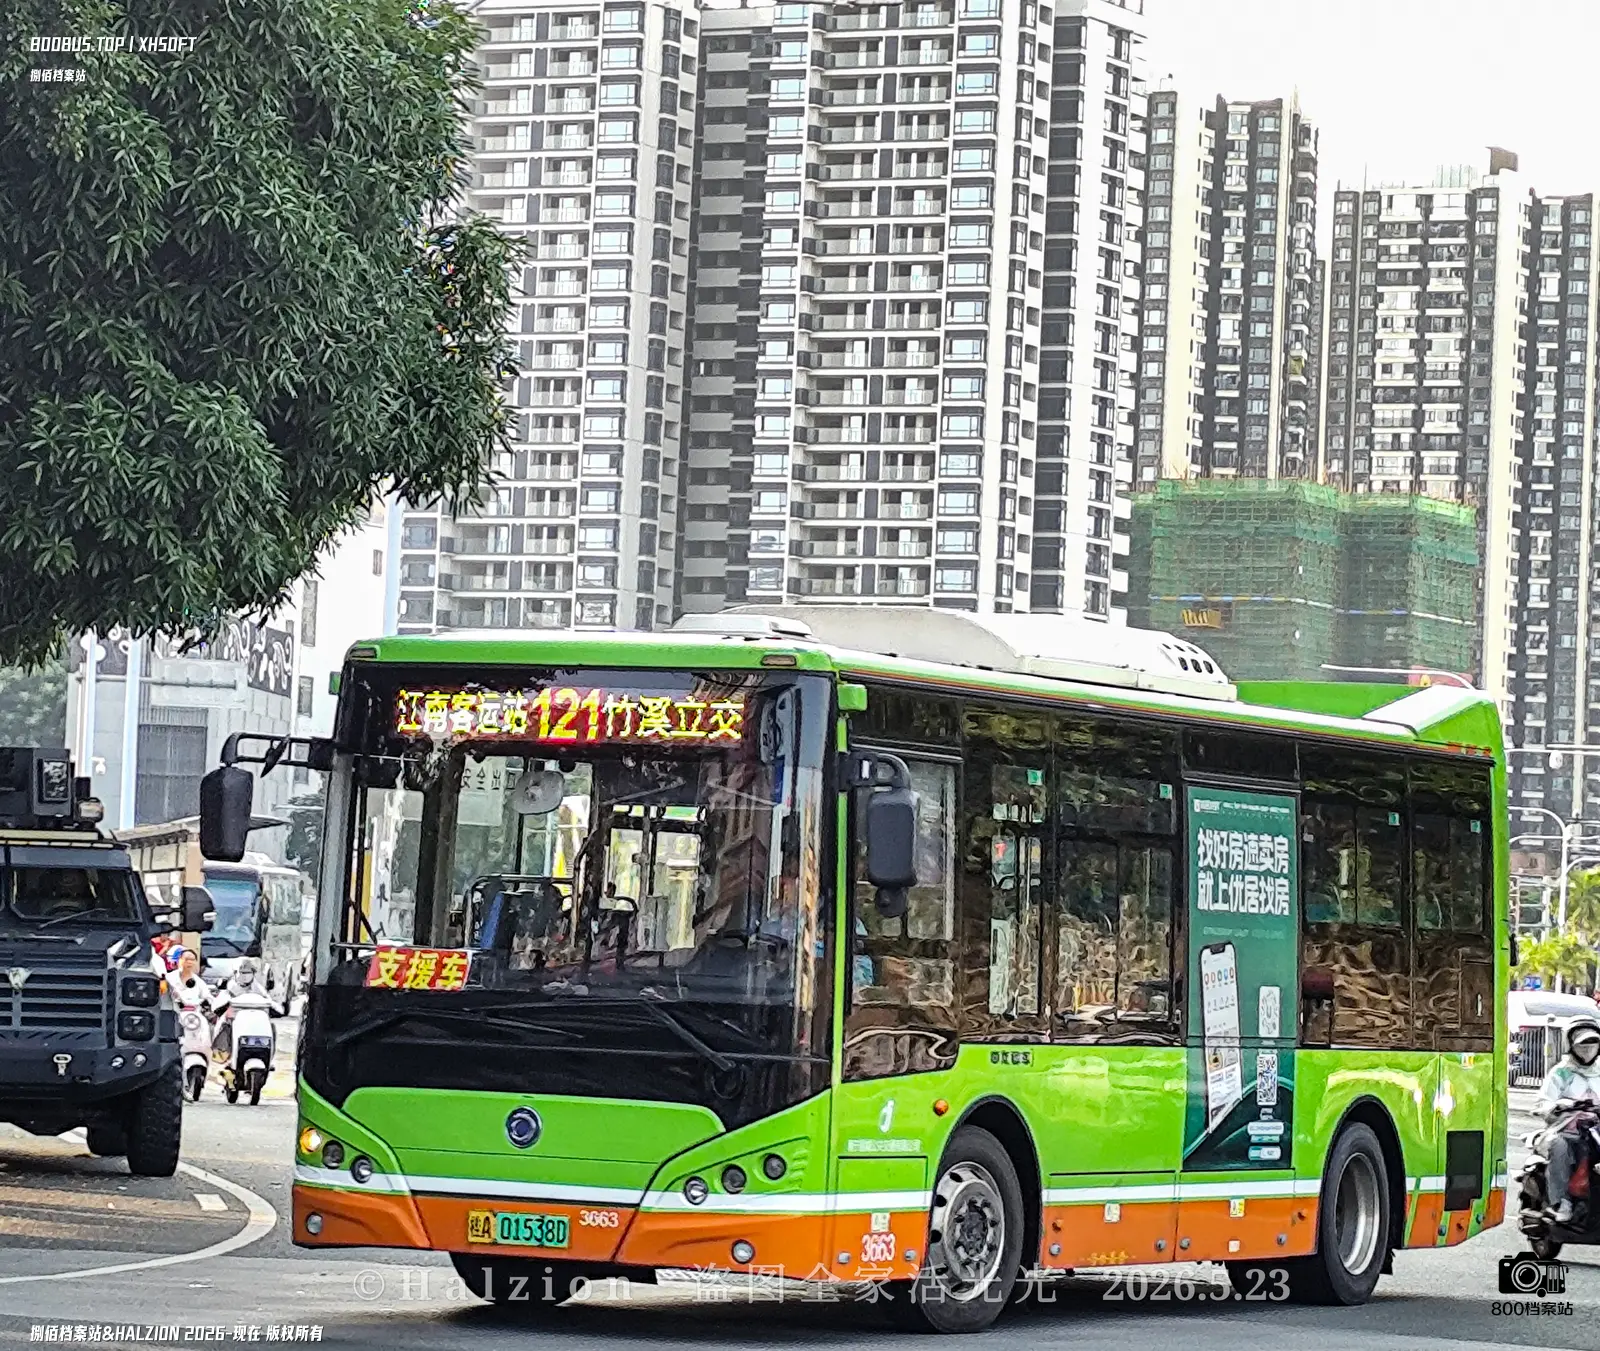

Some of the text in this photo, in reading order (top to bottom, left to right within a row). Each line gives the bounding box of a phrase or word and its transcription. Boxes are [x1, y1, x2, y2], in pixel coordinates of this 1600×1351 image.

[397, 687, 745, 740] 江南客运站 121 竹溪立交
[1197, 870, 1290, 916] 就上优居找房
[369, 947, 468, 991] 支援车
[579, 1209, 619, 1228] 3663
[861, 1233, 896, 1262] 3663
